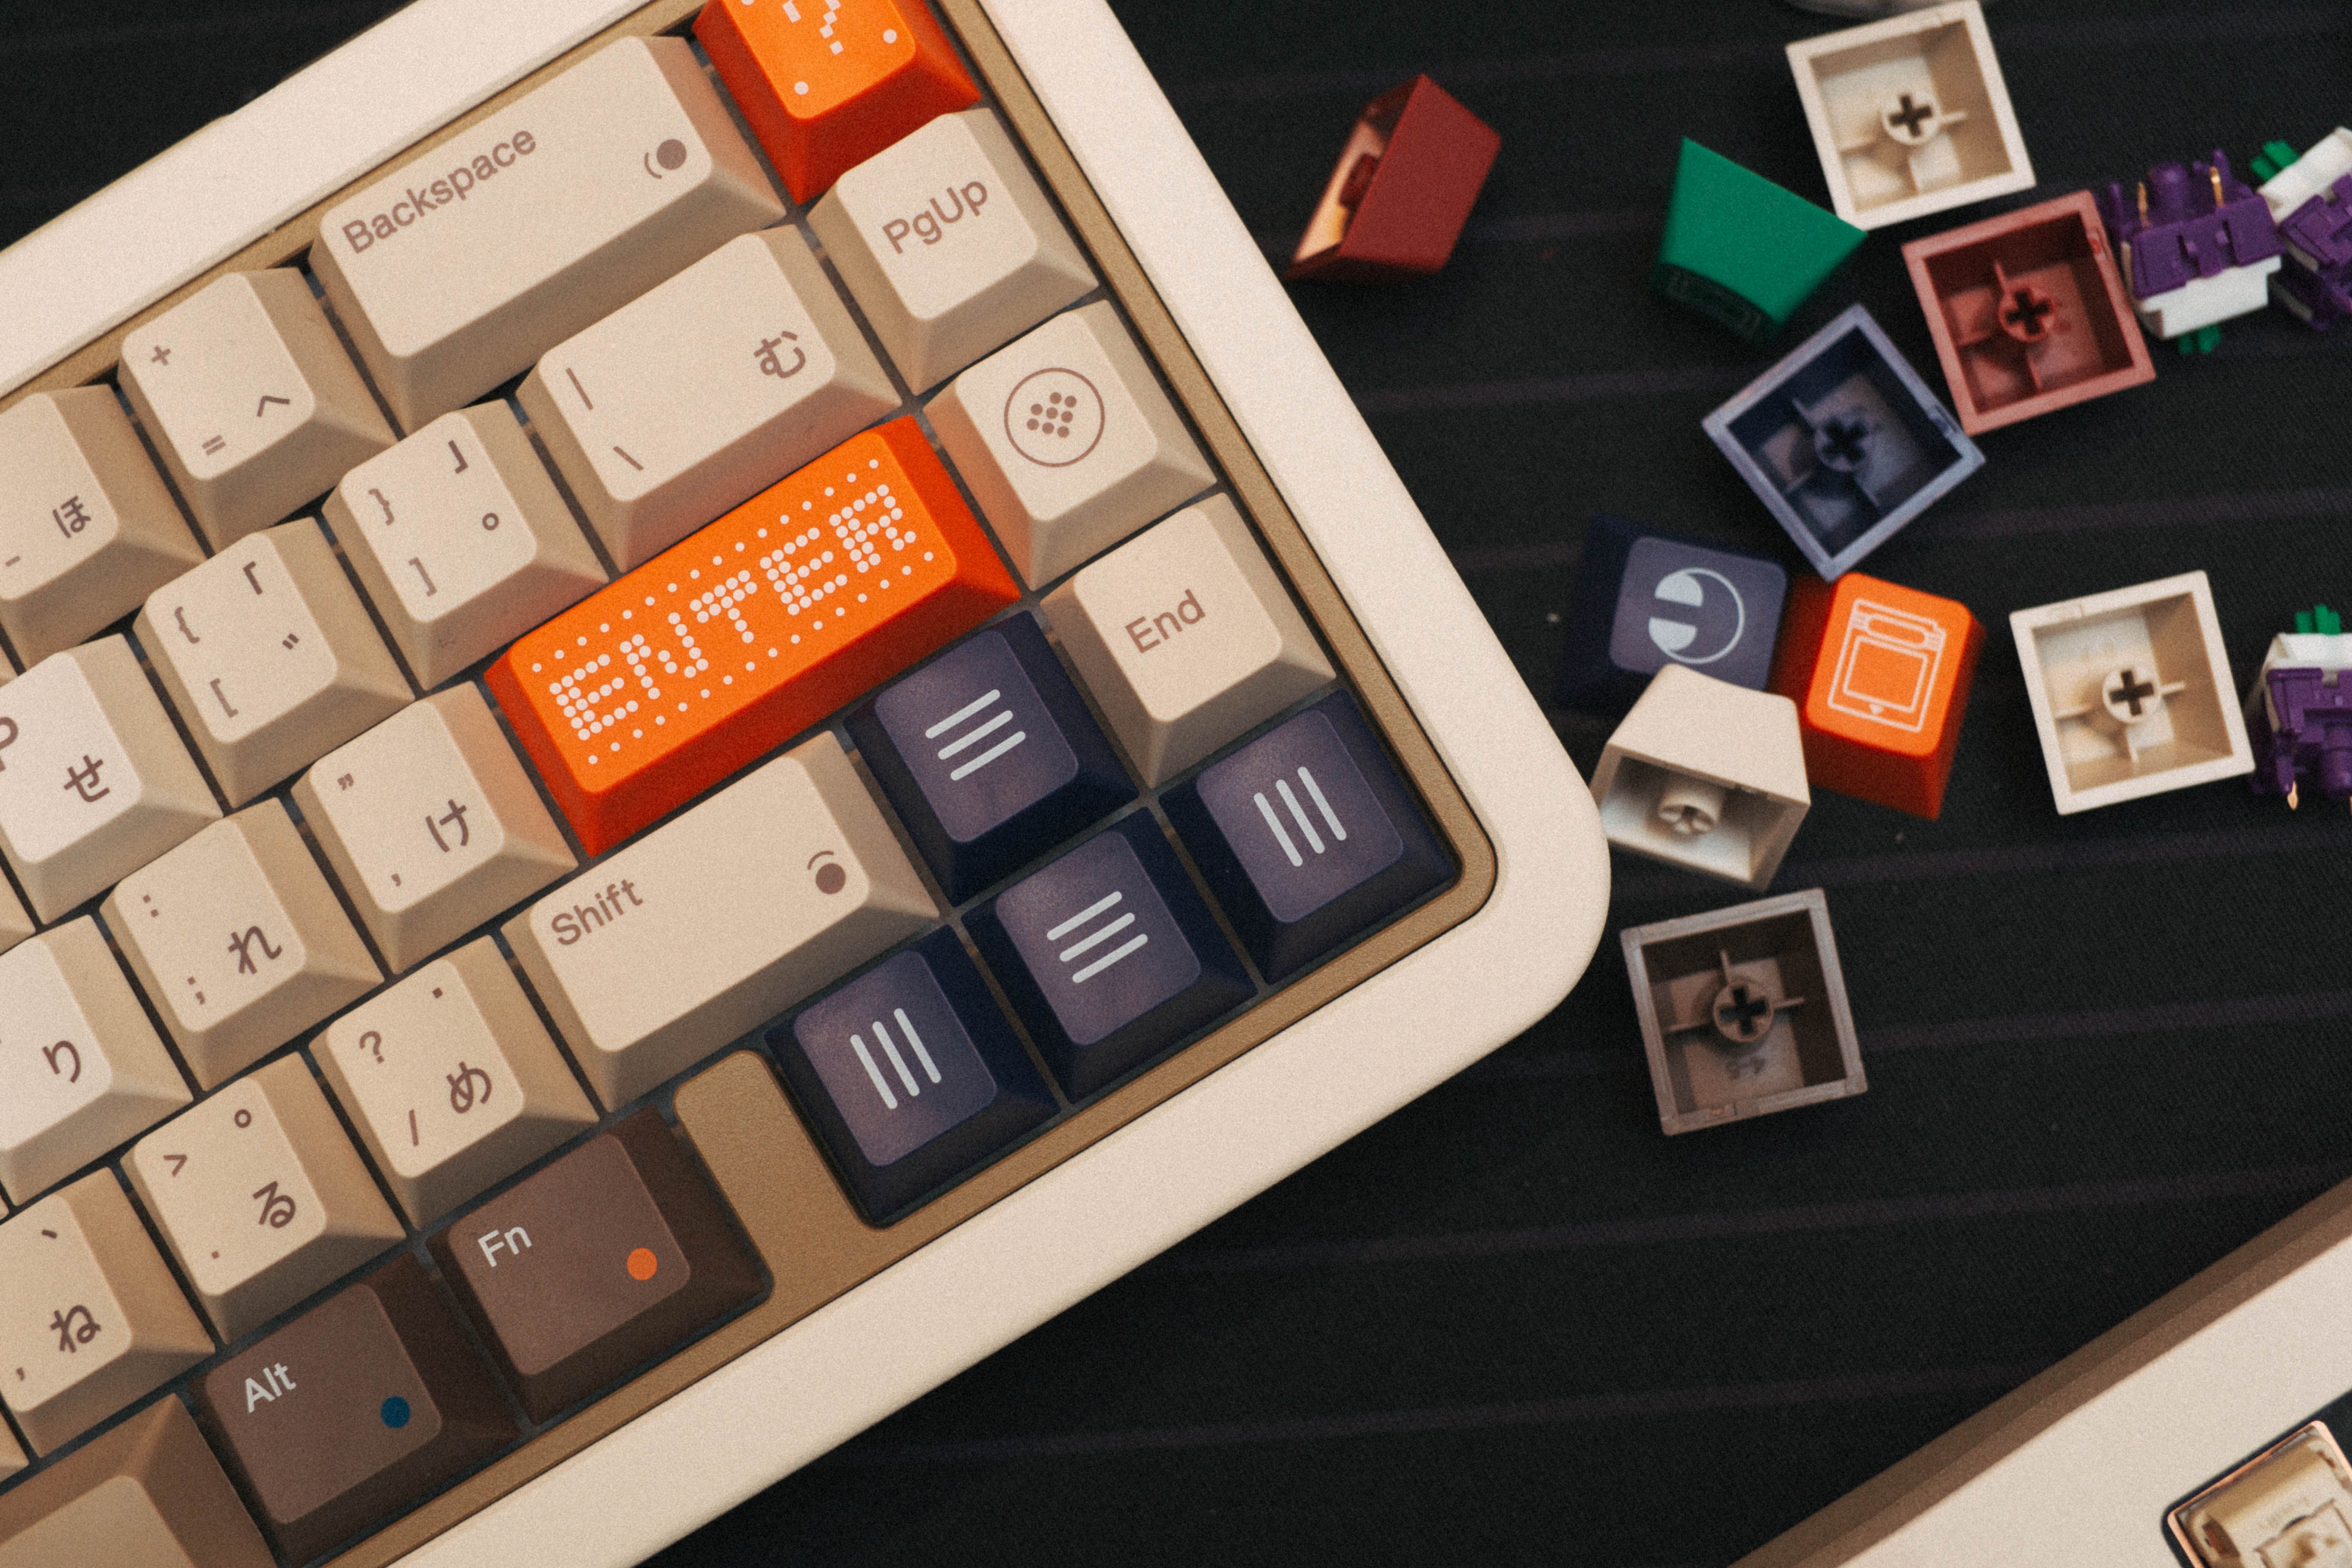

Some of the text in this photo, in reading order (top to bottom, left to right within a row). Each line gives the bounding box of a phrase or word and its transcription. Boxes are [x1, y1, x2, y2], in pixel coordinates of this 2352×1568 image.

[342, 130, 536, 253] Backspace
[882, 181, 987, 254] PgUp
[754, 331, 806, 379] む
[53, 495, 91, 538] ほ
[549, 484, 916, 741] ENTER
[1125, 589, 1205, 653] End
[64, 755, 110, 802] せ
[426, 799, 469, 852] け
[551, 879, 643, 945] Shift
[228, 926, 282, 974] れ
[42, 1040, 81, 1083] り
[359, 1031, 384, 1063] ?
[446, 1062, 492, 1114] め
[163, 1154, 187, 1176] >
[253, 1181, 296, 1229] る
[478, 1227, 532, 1267] Fn
[50, 1305, 101, 1353] ね
[245, 1363, 296, 1413] Alt
